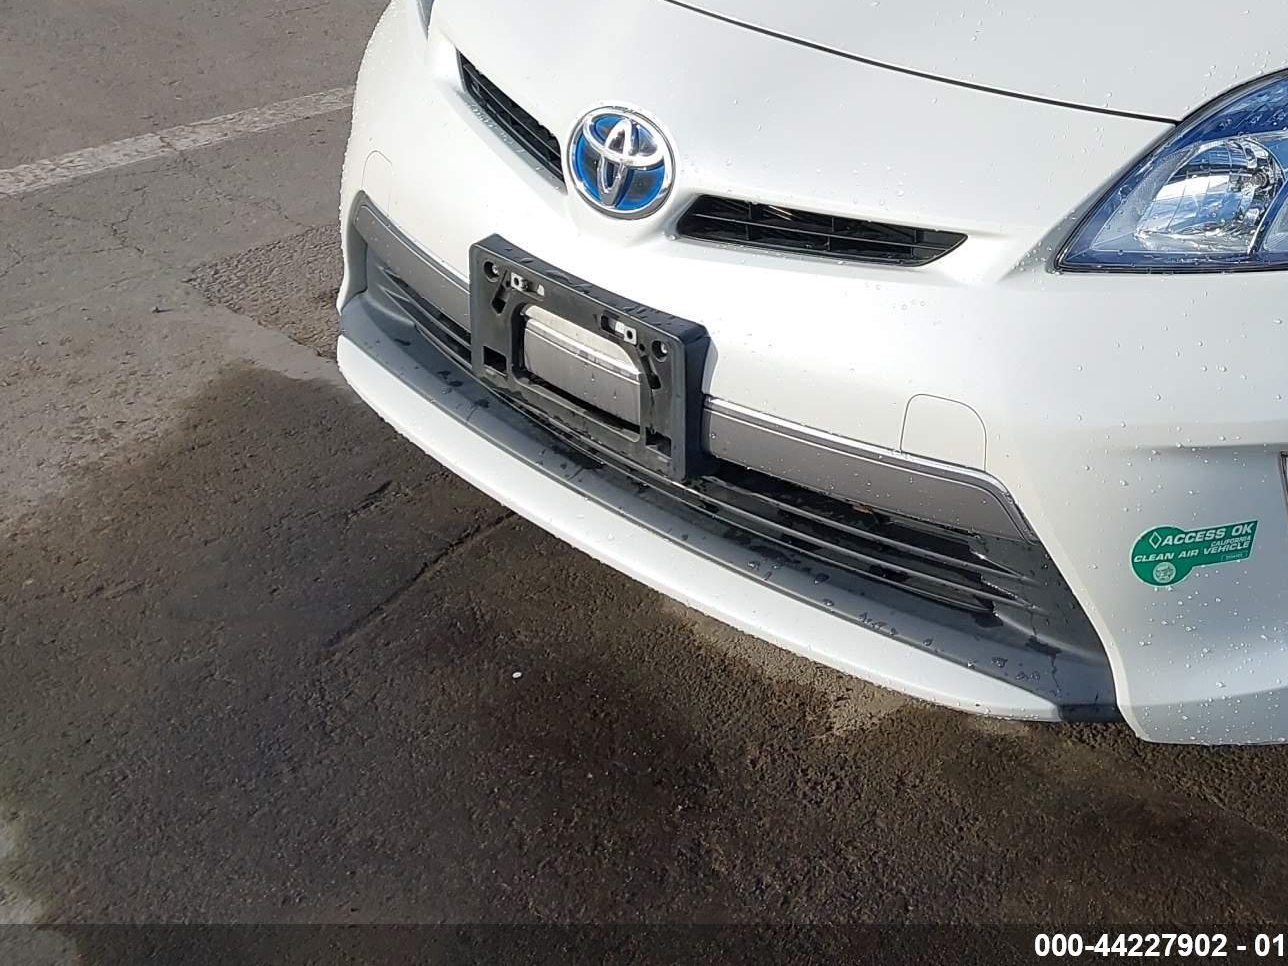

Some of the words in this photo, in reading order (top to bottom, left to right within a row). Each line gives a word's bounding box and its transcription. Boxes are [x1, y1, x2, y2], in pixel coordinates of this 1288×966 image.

[1161, 528, 1227, 547] ACCESS
[1231, 522, 1255, 537] OK
[1133, 552, 1175, 563] CLEAN
[1178, 549, 1199, 559] AIR
[1203, 541, 1251, 555] VEHICLE
